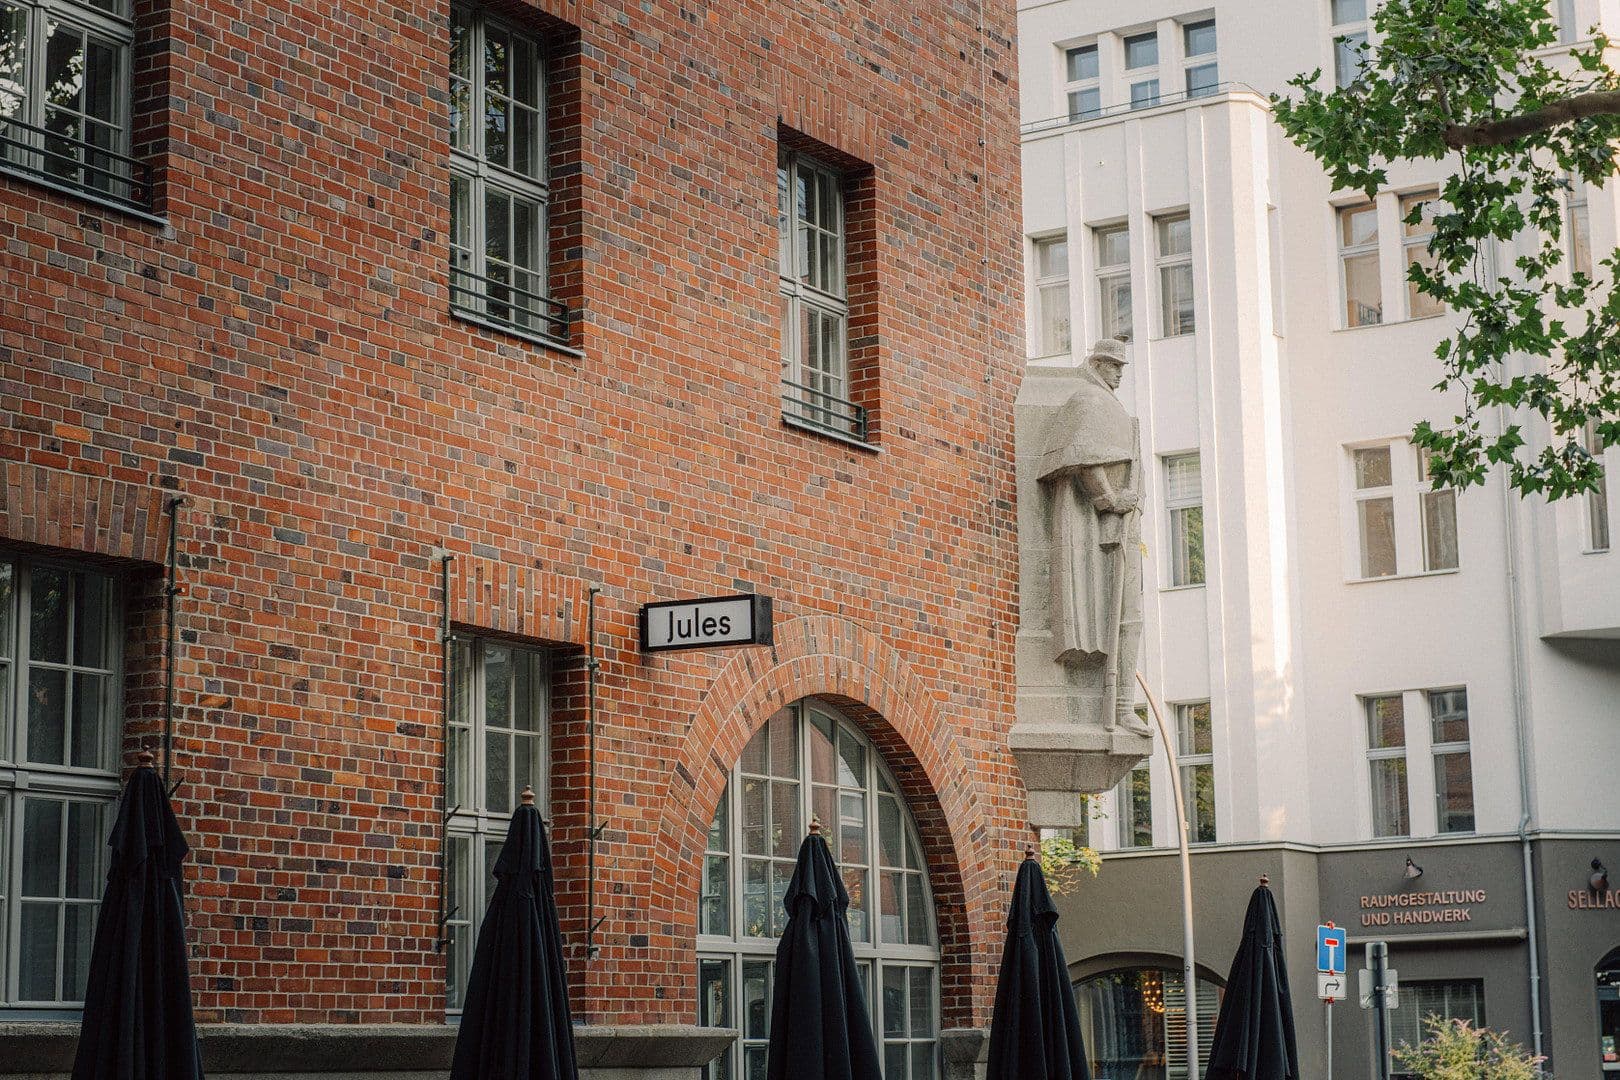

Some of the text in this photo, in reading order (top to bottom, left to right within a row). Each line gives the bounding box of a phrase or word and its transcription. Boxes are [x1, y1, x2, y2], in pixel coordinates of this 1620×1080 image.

[667, 607, 731, 642] Jules
[1360, 890, 1486, 908] RAUMGESTALTUNG
[1361, 908, 1471, 926] UND HANDWERK
